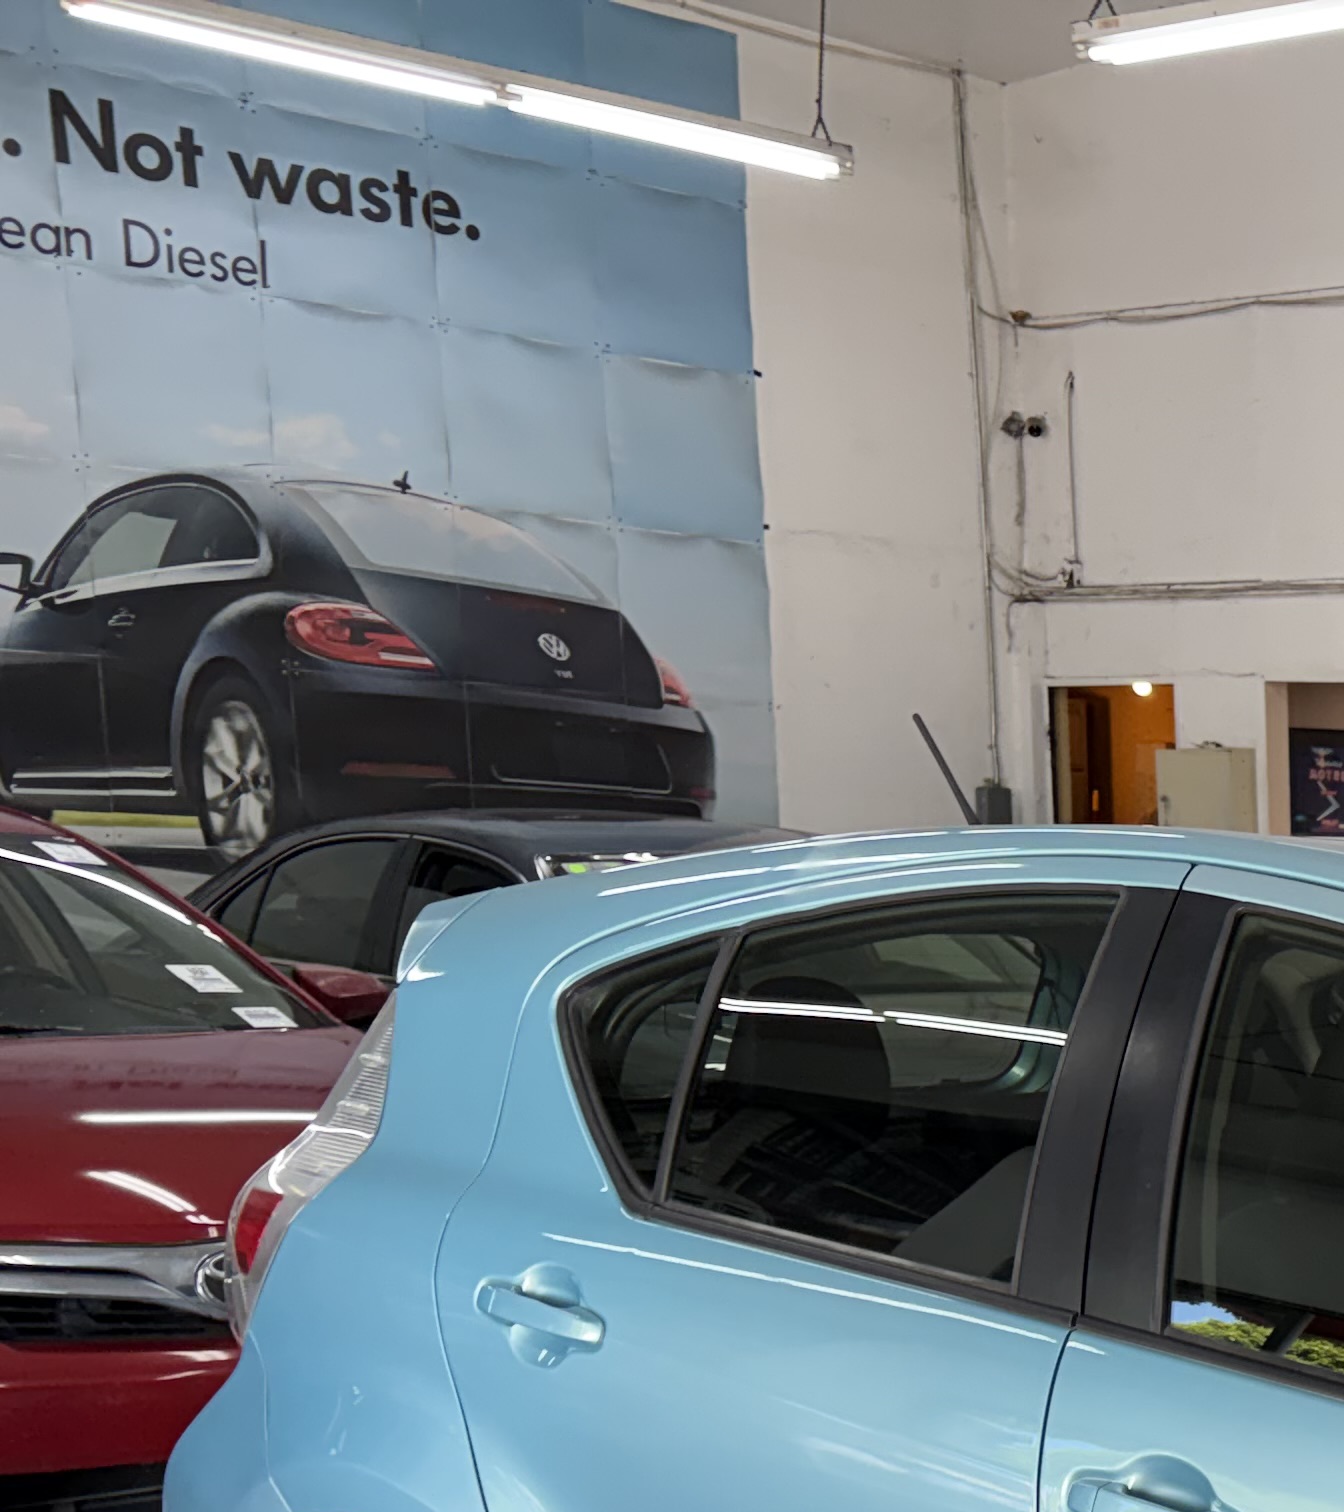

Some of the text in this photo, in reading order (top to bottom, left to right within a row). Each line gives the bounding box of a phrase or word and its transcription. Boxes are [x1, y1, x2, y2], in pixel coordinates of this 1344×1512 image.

[48, 87, 481, 242] Not waste.
[122, 218, 271, 289] Diesel
